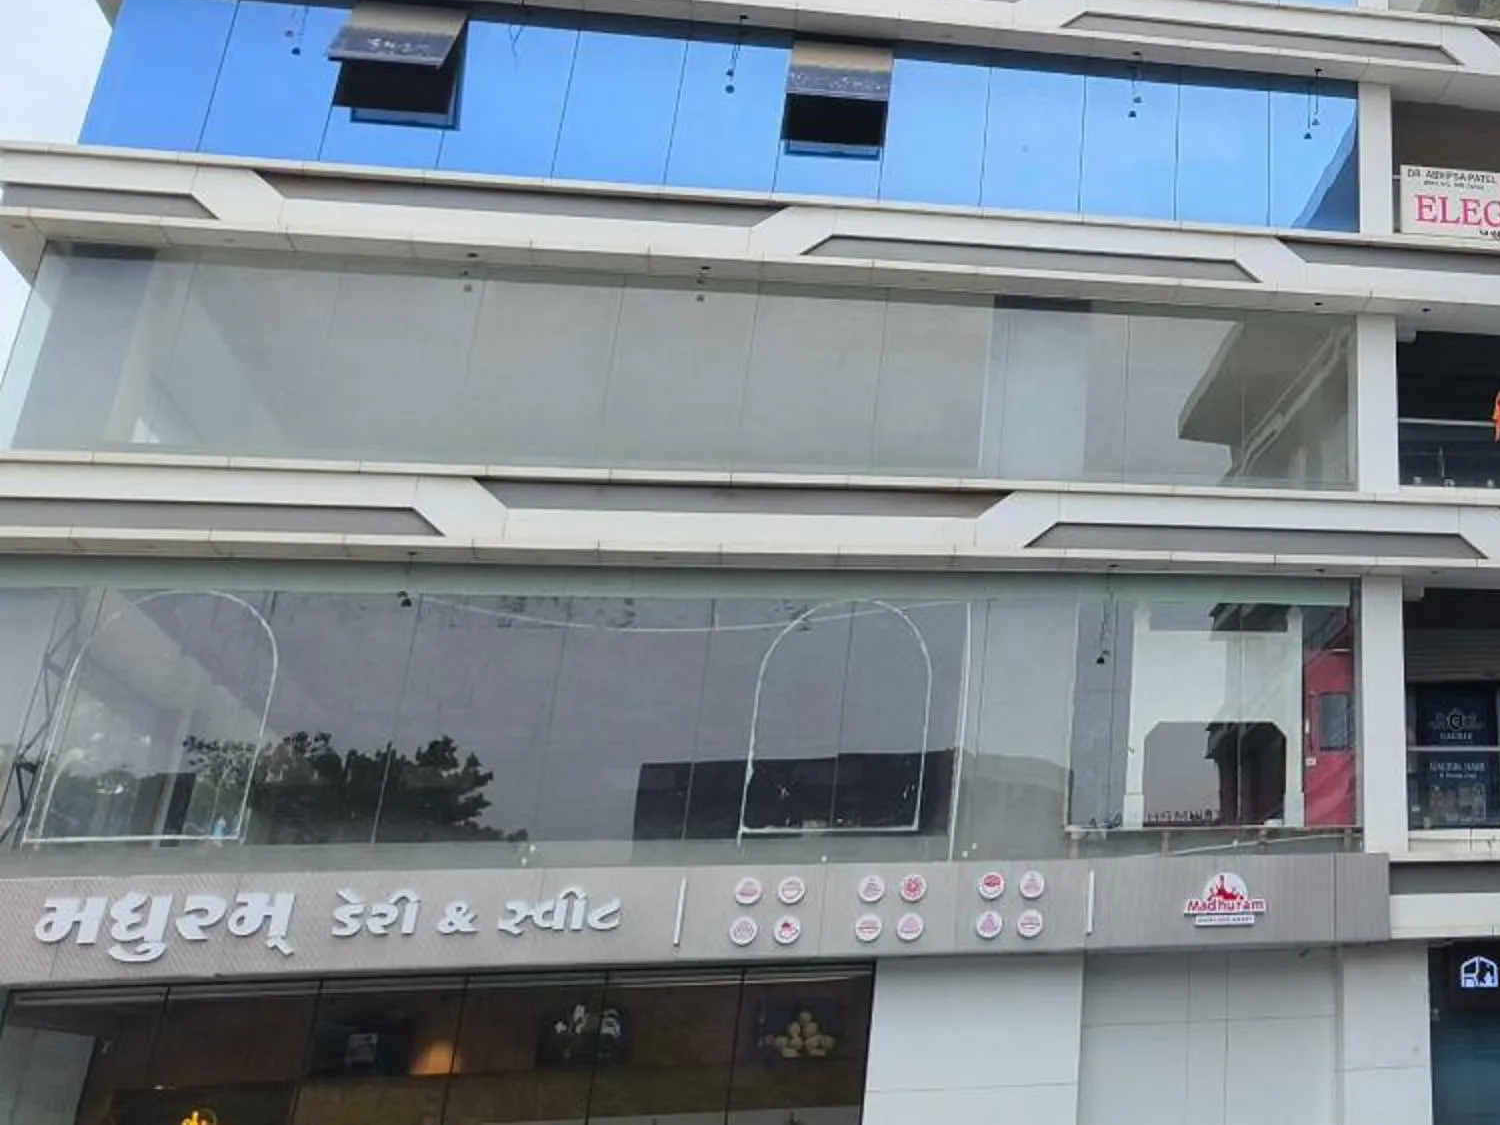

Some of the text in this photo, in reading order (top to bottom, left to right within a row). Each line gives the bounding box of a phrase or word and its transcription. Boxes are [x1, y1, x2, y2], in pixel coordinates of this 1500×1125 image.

[34, 891, 297, 962] મધુરમ્
[331, 887, 421, 939] ડેરી
[438, 900, 480, 935] &
[1186, 896, 1266, 912] Madhuram
